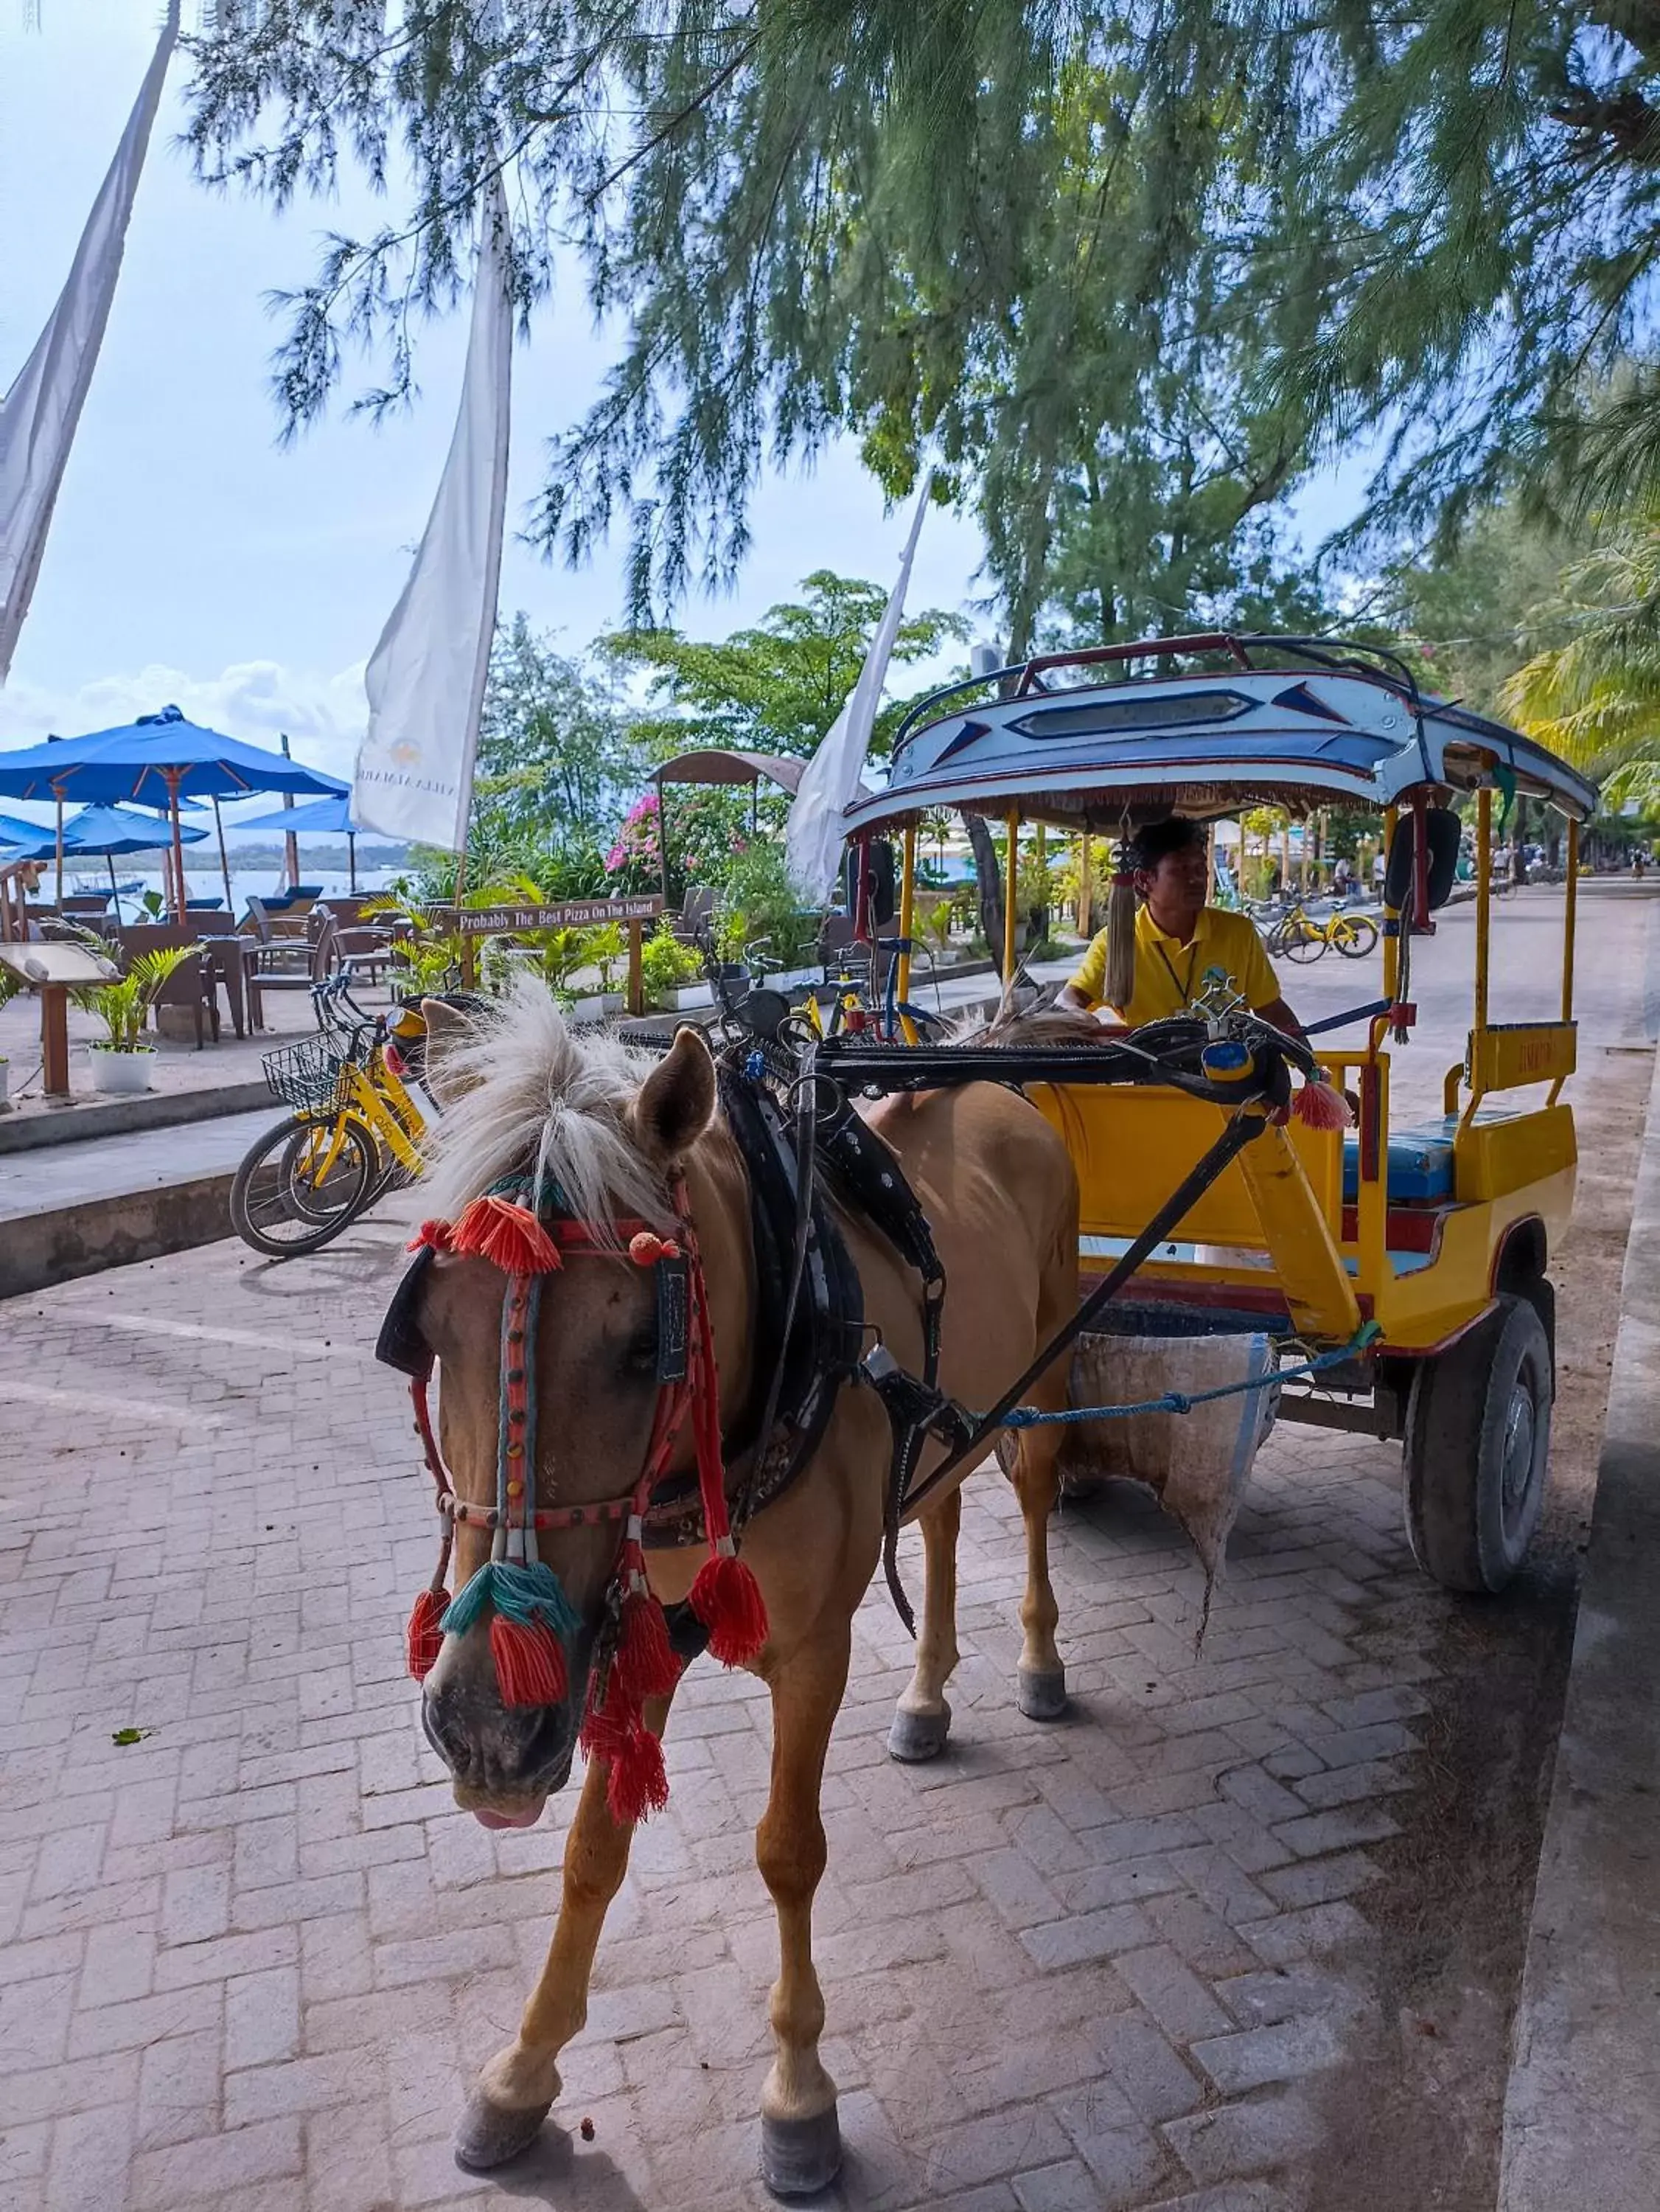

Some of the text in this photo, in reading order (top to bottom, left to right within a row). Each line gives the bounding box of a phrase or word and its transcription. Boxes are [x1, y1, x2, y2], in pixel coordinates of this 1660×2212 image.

[459, 900, 652, 930] Probably The Best Pizza On The Island
[374, 1115, 392, 1138] ofo
